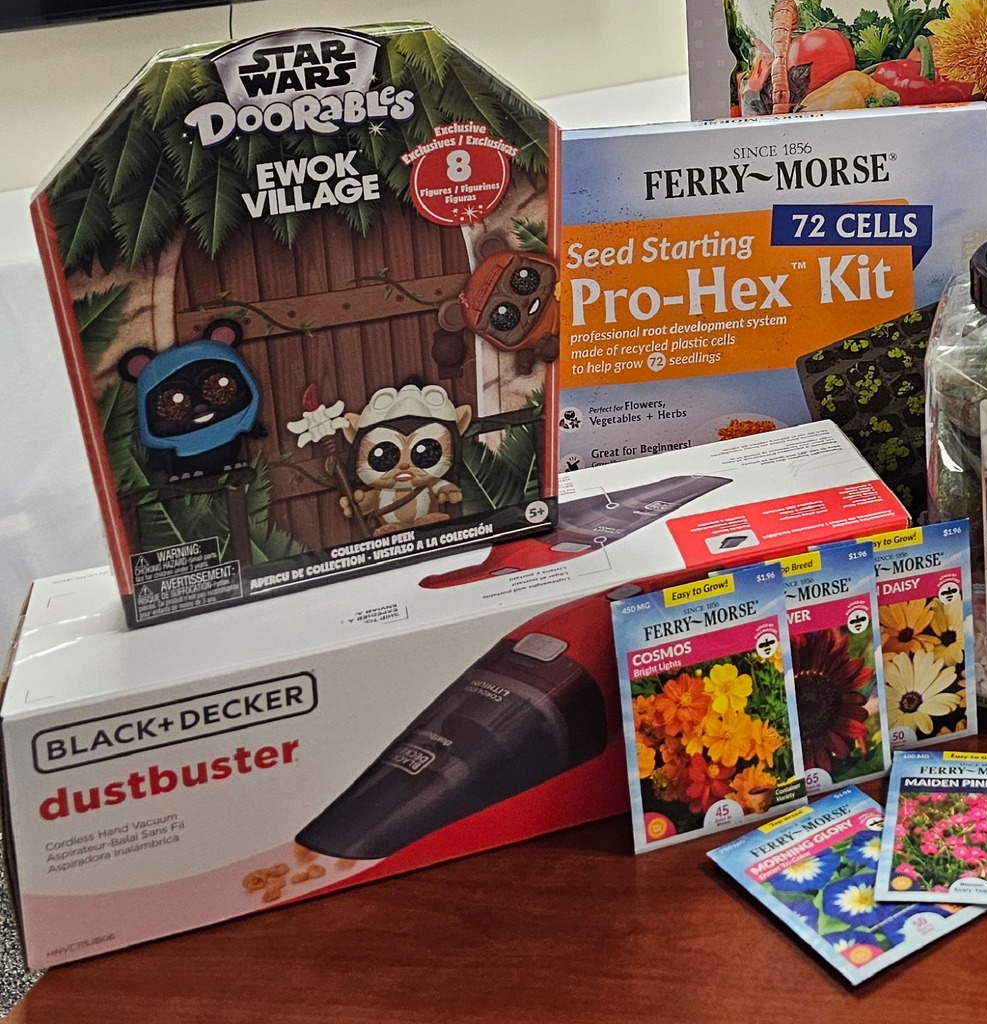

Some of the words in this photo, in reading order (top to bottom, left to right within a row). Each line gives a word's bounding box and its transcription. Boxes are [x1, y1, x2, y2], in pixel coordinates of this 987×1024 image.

[238, 39, 356, 75] STAR
[239, 60, 357, 98] WARS
[434, 121, 487, 137] Exclusive
[401, 137, 456, 165] Exclusives
[466, 135, 519, 157] Exclusivas
[733, 144, 778, 160] SINCE
[781, 142, 813, 157] 1856
[256, 150, 359, 191] EWOK
[446, 149, 472, 182] 8
[241, 173, 381, 219] VILLAGE
[420, 187, 452, 198] Figures
[460, 182, 500, 193] Figurines
[445, 194, 476, 204] Figuras
[792, 213, 826, 239] 72
[836, 212, 918, 239] CELLS
[566, 236, 635, 270] Seed
[641, 230, 755, 265] Starting
[818, 253, 895, 305] Kit
[570, 326, 640, 346] professional
[642, 324, 668, 338] root
[669, 318, 744, 339] development
[746, 314, 787, 332] system
[571, 344, 600, 360] made
[601, 342, 619, 357] of
[620, 338, 669, 356] recycled
[671, 336, 712, 354] plastic
[714, 333, 736, 348] cells
[571, 363, 584, 376] to
[587, 359, 613, 377] help
[615, 358, 644, 373] grow
[648, 356, 664, 369] 72
[668, 350, 722, 370] seedlings
[588, 406, 612, 414] Perfect
[625, 399, 666, 411] Flowers,
[590, 414, 642, 428] Vegetables
[657, 409, 687, 420] Herbs
[591, 448, 619, 459] Great
[622, 446, 637, 456] for
[640, 439, 692, 455] Beginners!
[529, 505, 547, 519] 5+
[893, 532, 917, 543] Grow!
[943, 527, 962, 537] $1.96
[156, 543, 202, 562] WARNING:
[331, 537, 390, 559] COLLECTION
[391, 531, 416, 546] PEEK
[848, 550, 867, 561] $1.96
[291, 568, 305, 580] DE
[306, 553, 366, 576] COLLECTION
[373, 543, 414, 561] VISTAZO
[416, 539, 425, 551] A
[426, 536, 439, 549] LA
[791, 560, 813, 571] Breed
[161, 565, 236, 592] AVERTISSEMENT:
[756, 572, 775, 583] $1.96
[883, 578, 920, 595] DAISY
[672, 590, 690, 601] Easy
[692, 586, 702, 595] to
[703, 579, 728, 594] Grow!
[621, 604, 637, 614] 450
[637, 601, 651, 611] MG
[683, 605, 704, 615] SINCE
[632, 641, 692, 667] COSMOS
[633, 663, 658, 678] Bright
[659, 660, 682, 673] Lights
[892, 731, 905, 741] 50
[39, 739, 300, 822] dustbuster
[806, 773, 819, 785] 65
[904, 778, 959, 787] MAIDEN
[716, 804, 729, 817] 45
[45, 832, 95, 852] Cordless
[98, 824, 129, 839] Hand
[132, 813, 178, 830] Vacuum
[46, 834, 139, 863] Aspirateur-Balai
[141, 826, 168, 839] Sans
[171, 820, 185, 832] Fil
[750, 839, 815, 876] MORNING
[814, 819, 853, 844] GLORY
[47, 851, 112, 874] Aspiradora
